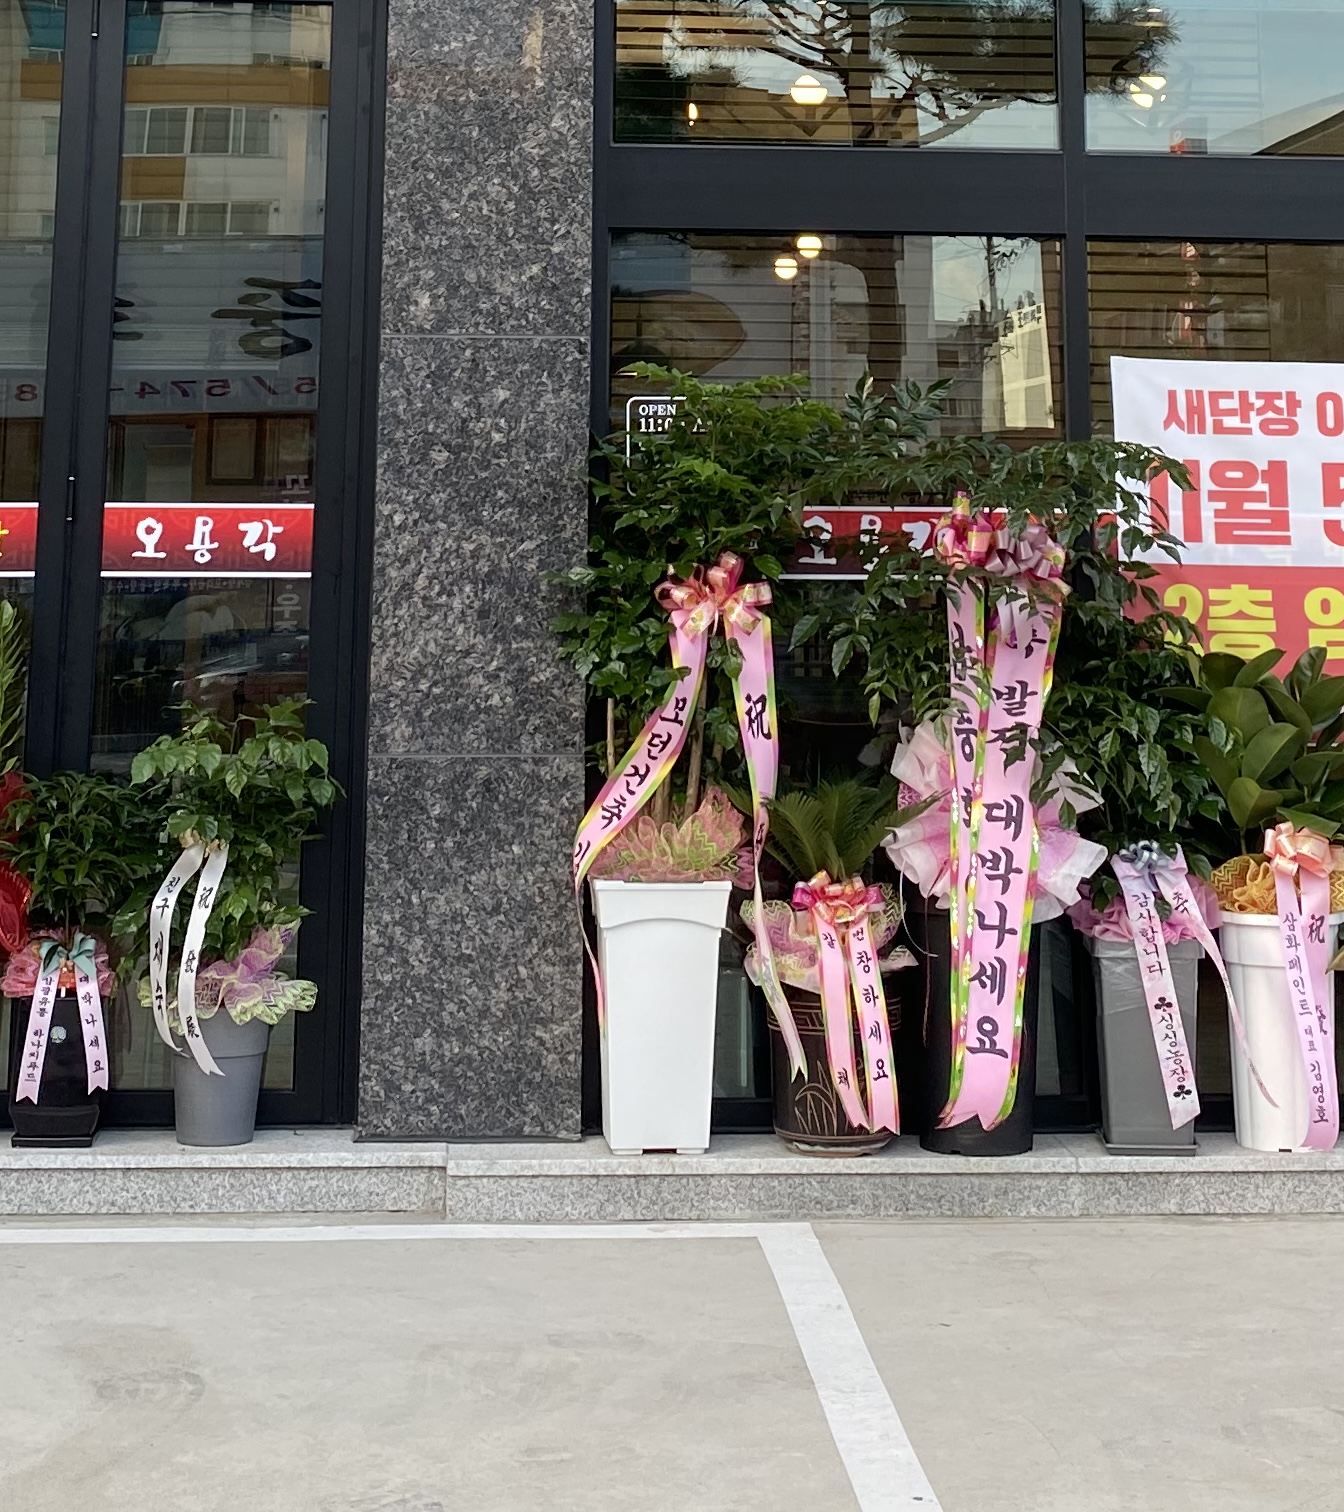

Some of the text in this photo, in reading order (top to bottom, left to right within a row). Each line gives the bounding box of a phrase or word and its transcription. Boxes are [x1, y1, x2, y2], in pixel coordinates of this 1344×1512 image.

[638, 404, 677, 416] OPEN
[1163, 390, 1301, 437] 새단장
[131, 516, 284, 564] 오용각
[966, 793, 1025, 1060] 대박나세요
